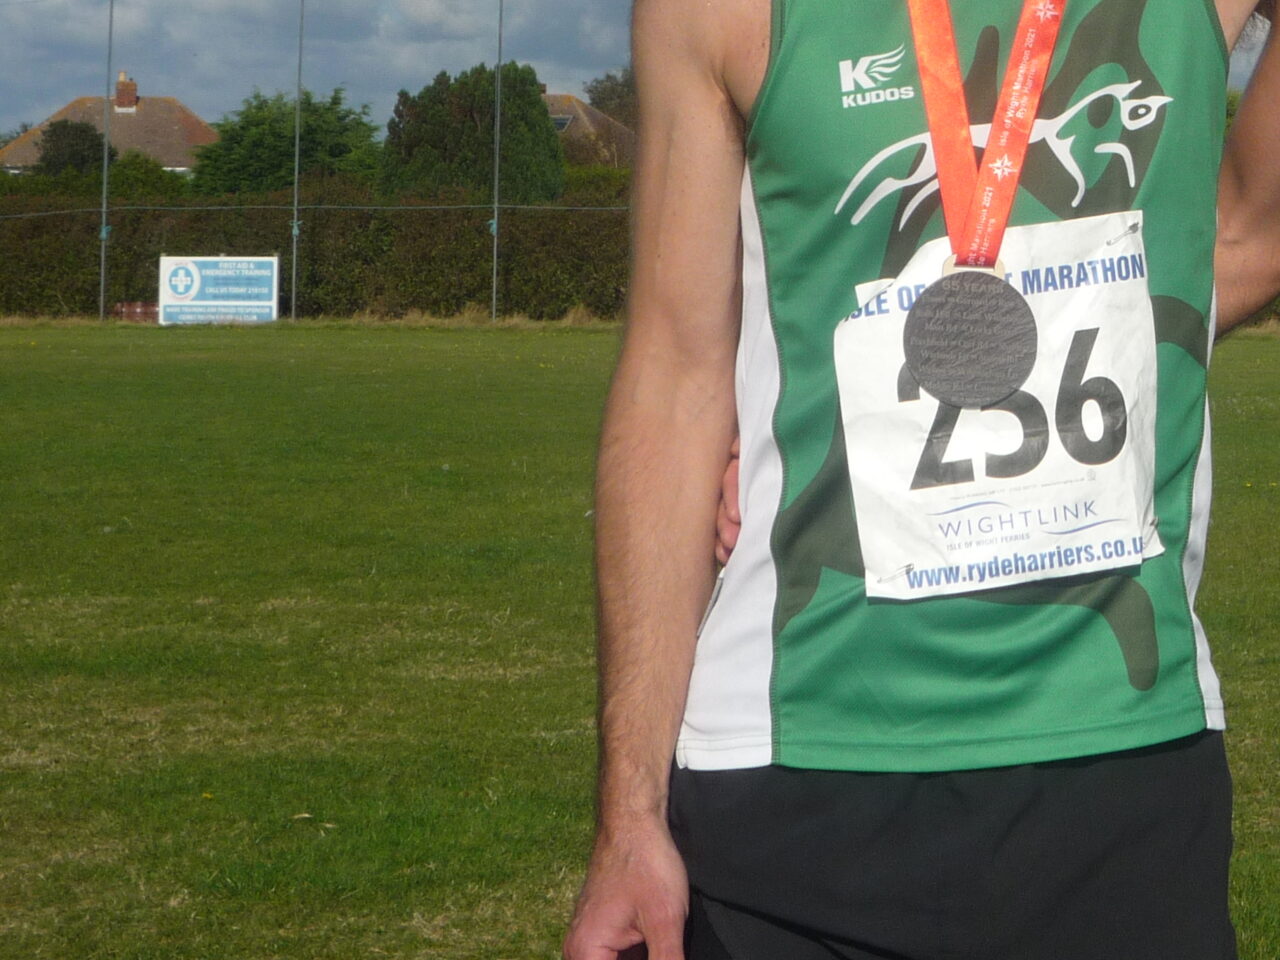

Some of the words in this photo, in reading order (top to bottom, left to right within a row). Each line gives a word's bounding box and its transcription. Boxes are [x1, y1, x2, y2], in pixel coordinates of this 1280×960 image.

[1006, 87, 1020, 118] Wight
[1014, 49, 1030, 88] Marathon
[1025, 28, 1036, 47] 2021
[842, 86, 914, 108] KUDOS
[983, 186, 994, 207] 2021
[1022, 254, 1145, 295] MARATHON
[939, 500, 1098, 538] WIGHTLINK
[947, 542, 962, 552] ISLE
[964, 540, 973, 548] OF
[975, 538, 998, 547] WIGHT
[1001, 533, 1030, 543] FERRIES
[906, 536, 1144, 589] www.rydeharriers.co.u
